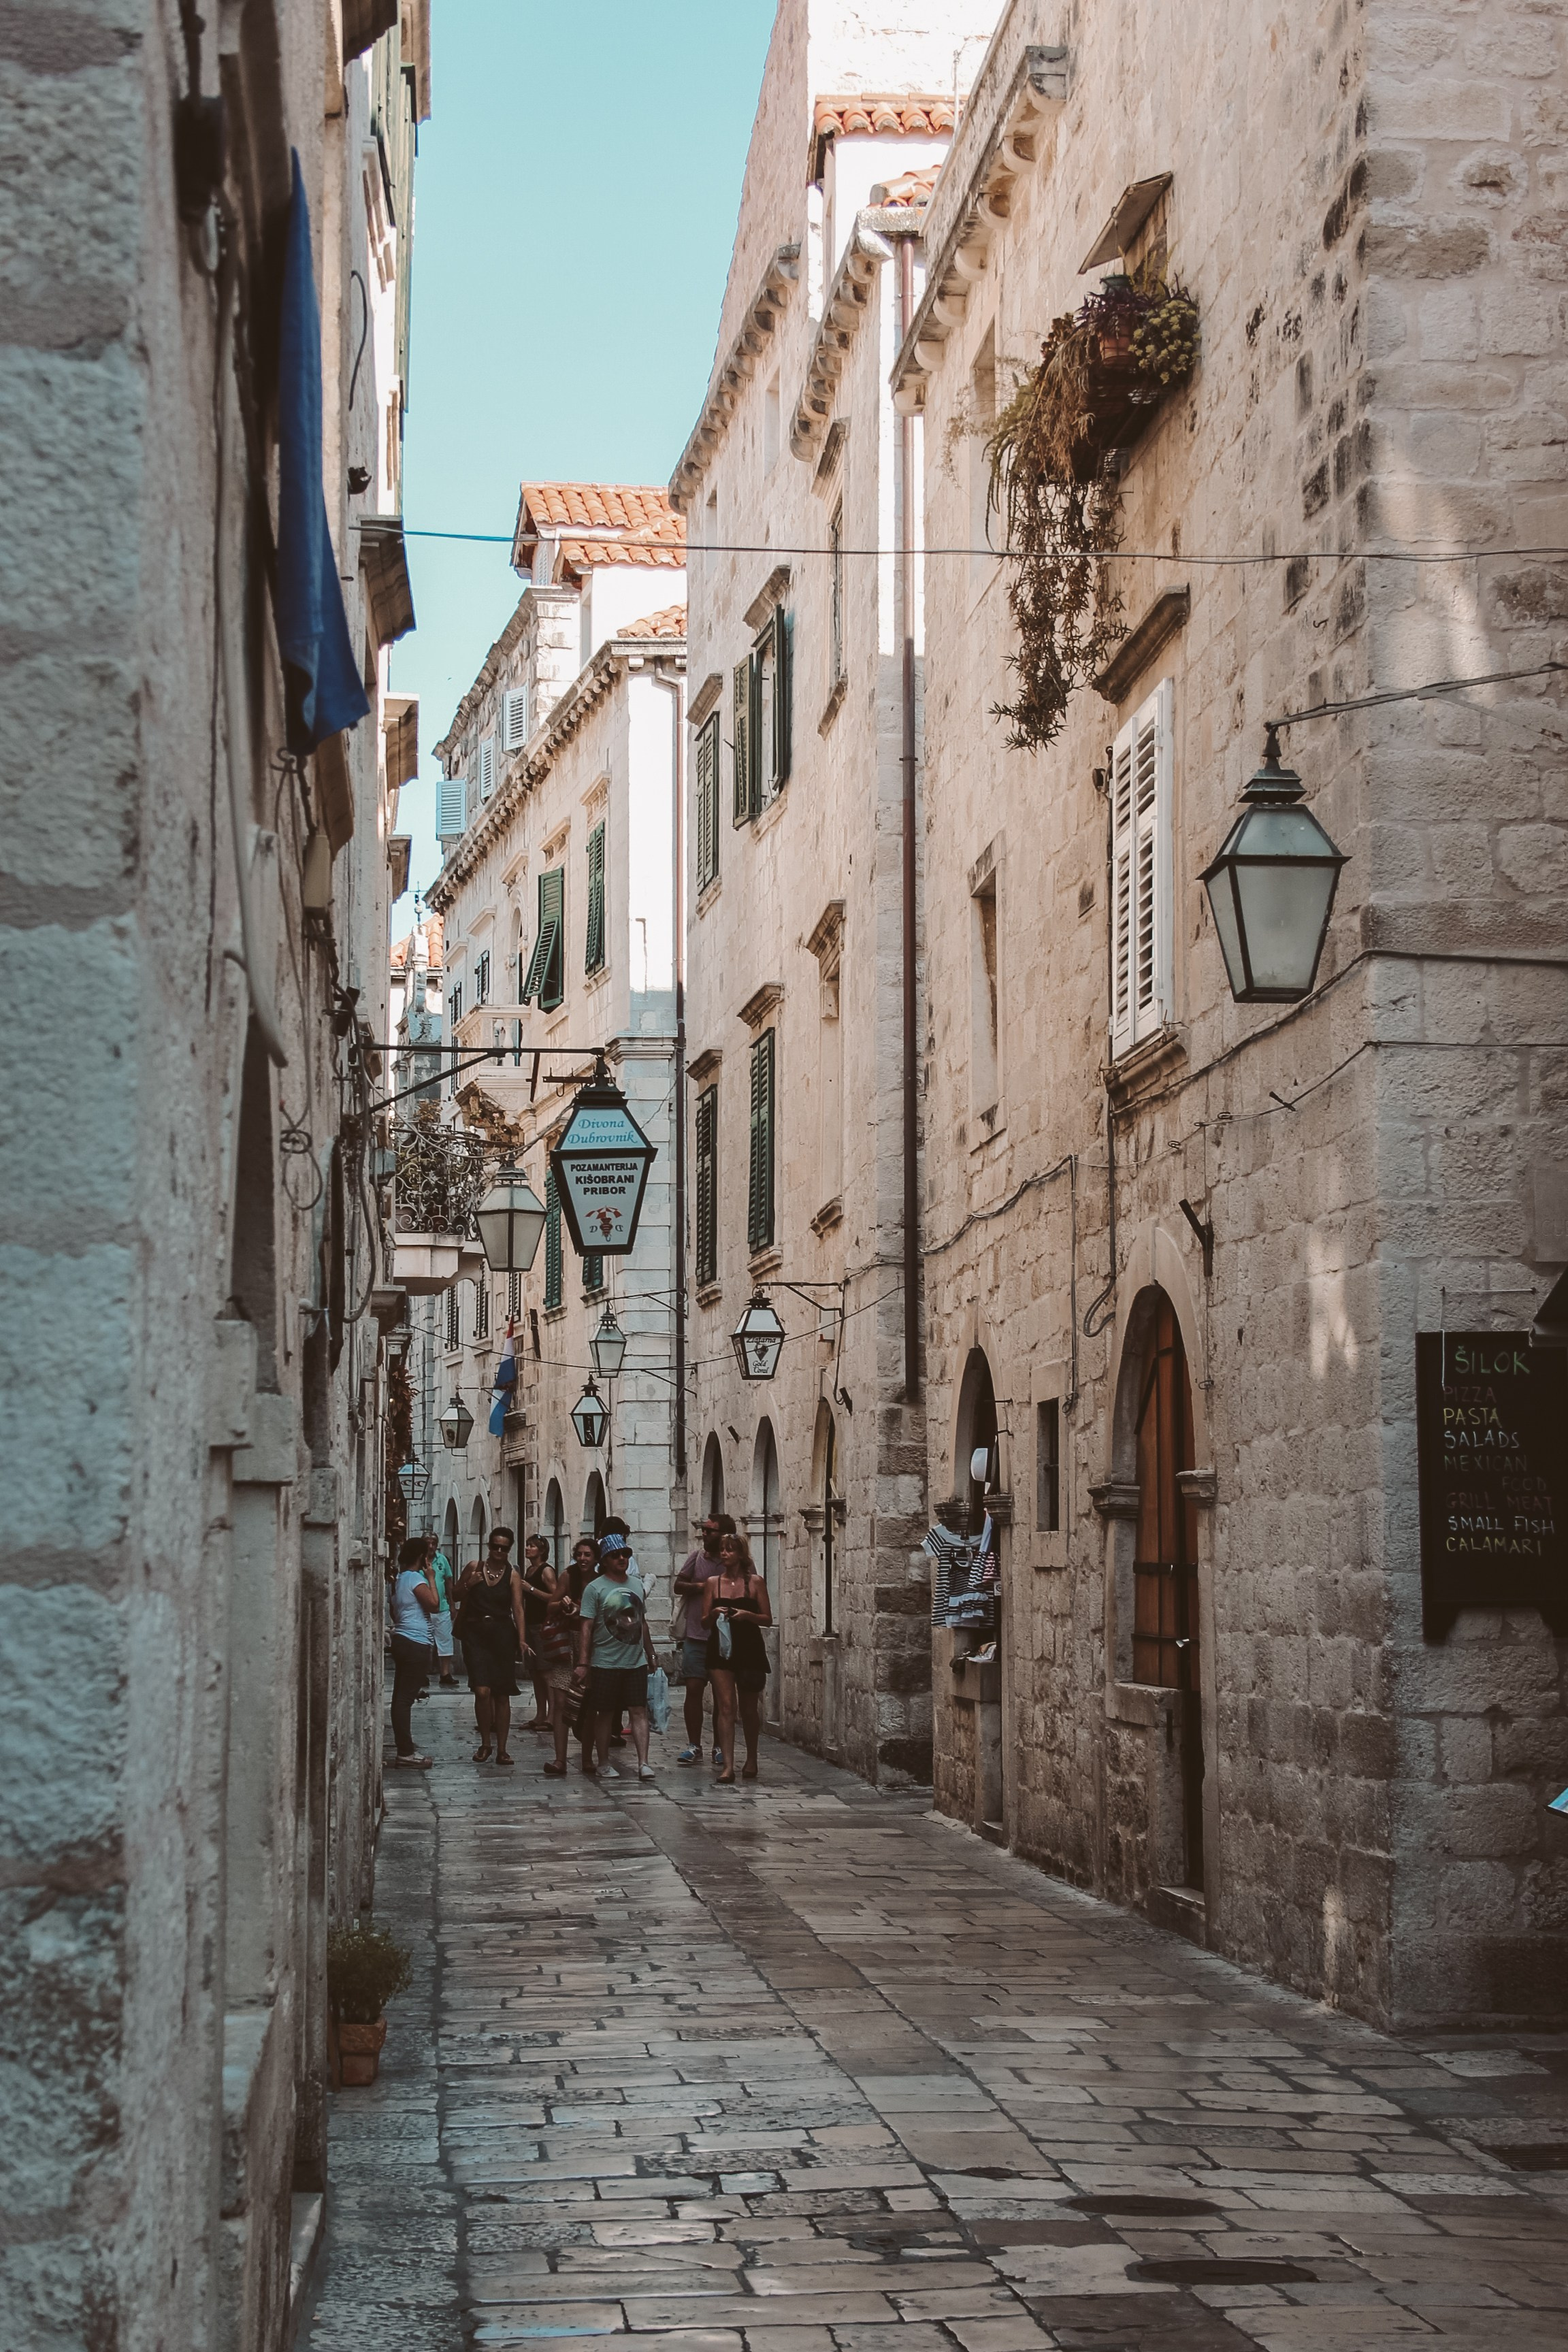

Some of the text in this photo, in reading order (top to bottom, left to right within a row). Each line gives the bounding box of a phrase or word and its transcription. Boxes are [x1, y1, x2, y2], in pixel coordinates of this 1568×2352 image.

[578, 1118, 625, 1129] Divona
[568, 1131, 638, 1144] Dubrovnik
[570, 1162, 638, 1173] POZAMANTERIJA
[575, 1174, 635, 1185] KIŠOBRANI
[583, 1187, 626, 1195] PRIBOR
[1455, 1345, 1531, 1375] ŠILOK
[1443, 1386, 1497, 1403] PIZZA
[1443, 1407, 1502, 1428] PASTA
[1444, 1430, 1520, 1448] SALADS
[1444, 1454, 1527, 1472] MEXICAN
[1502, 1476, 1547, 1492] FOOD
[1446, 1492, 1552, 1516] GRILL MEAT
[1448, 1516, 1555, 1535] SMALL FISH
[1446, 1537, 1541, 1556] CALAMARI
